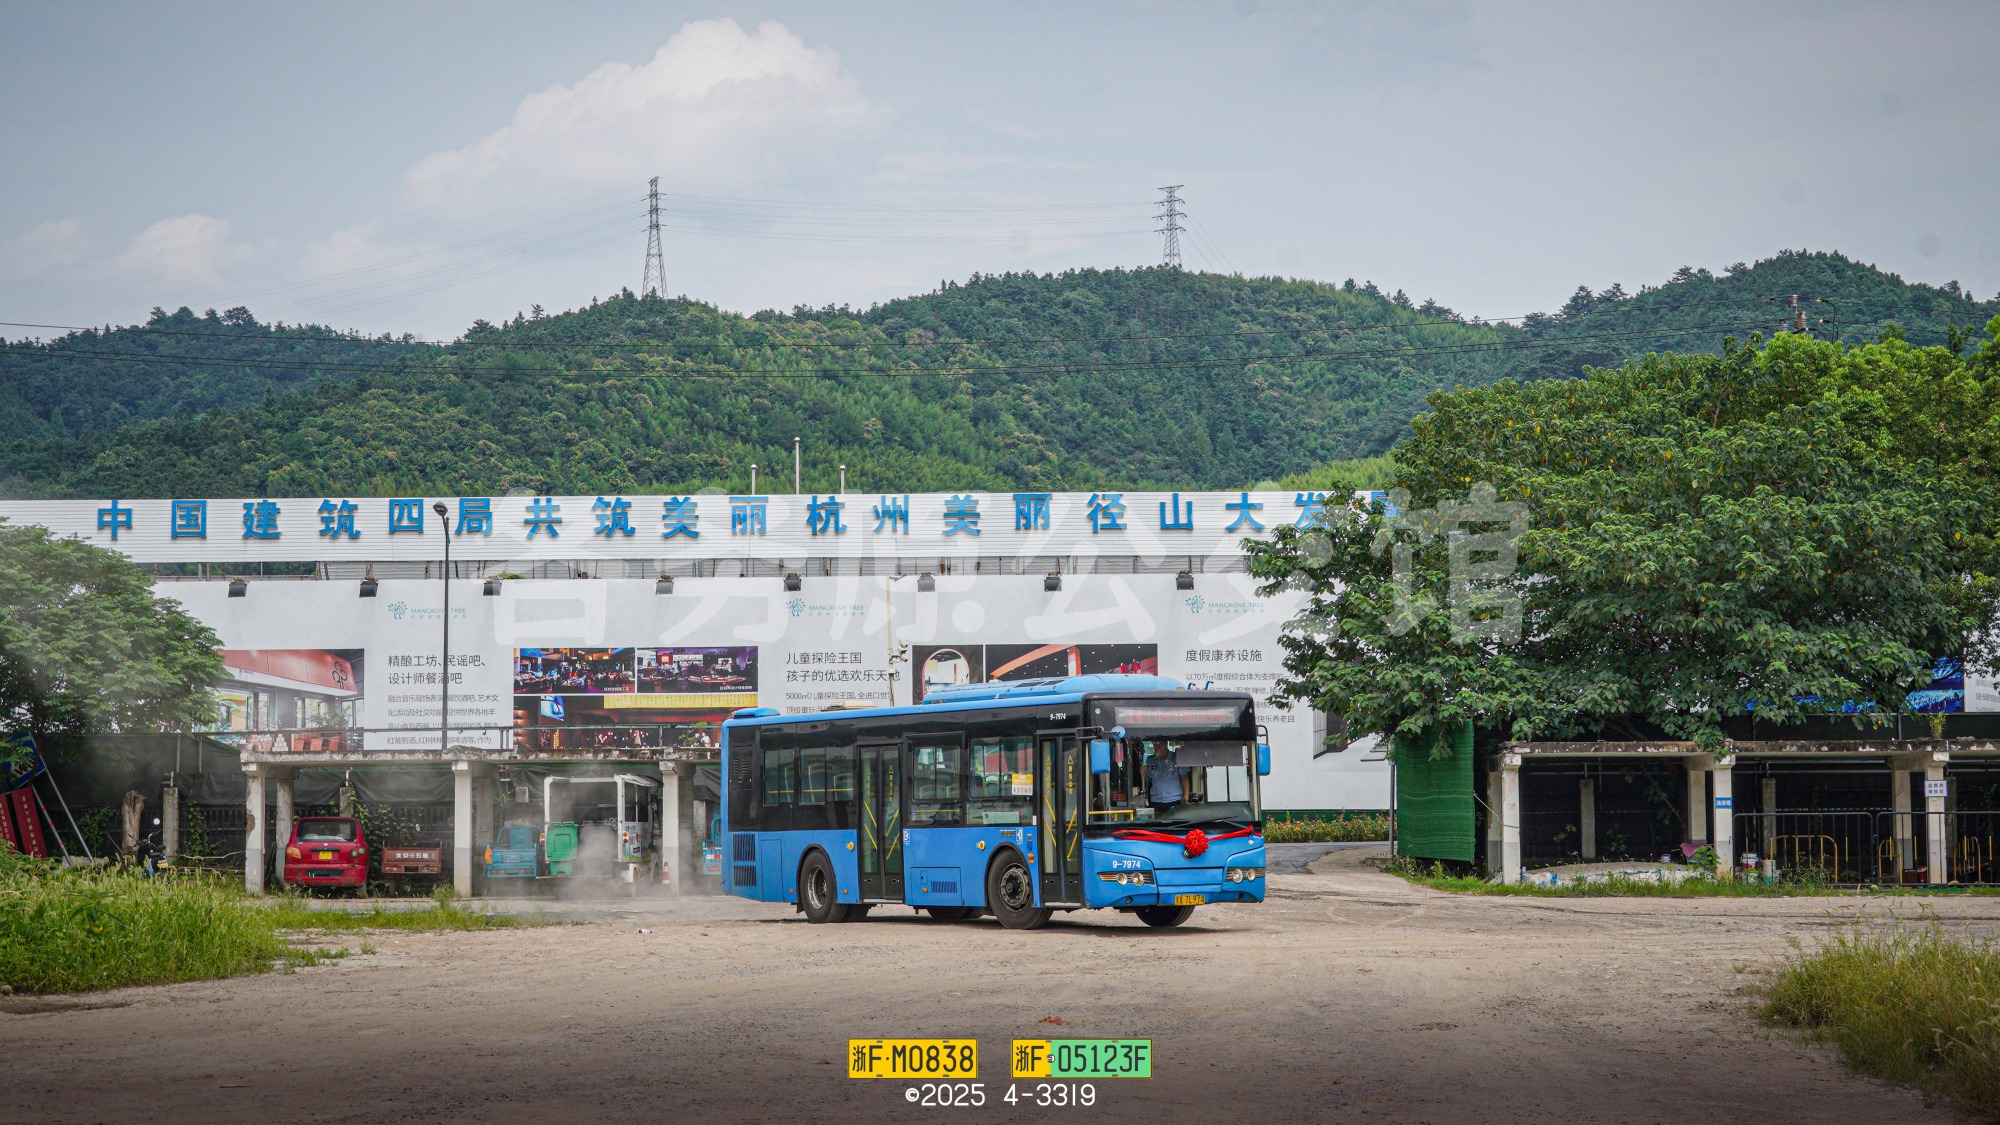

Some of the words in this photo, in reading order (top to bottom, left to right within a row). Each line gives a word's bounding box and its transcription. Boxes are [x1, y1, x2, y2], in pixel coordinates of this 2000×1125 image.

[388, 654, 485, 667] 精酿工坊、民谣吧、
[786, 652, 862, 664] 儿童探险王国
[1186, 649, 1263, 662] 度假康养设施
[388, 672, 463, 685] 设计师餐酒吧
[786, 669, 901, 682] 孩子的优选欢乐天地
[387, 694, 500, 703] 融合音乐现场表演餐饮酒吧、艺术文
[387, 708, 496, 717] 化活动及社交功能提供世界各地丰
[1049, 712, 1066, 721] 9-7974
[1112, 860, 1141, 869] 9-7974
